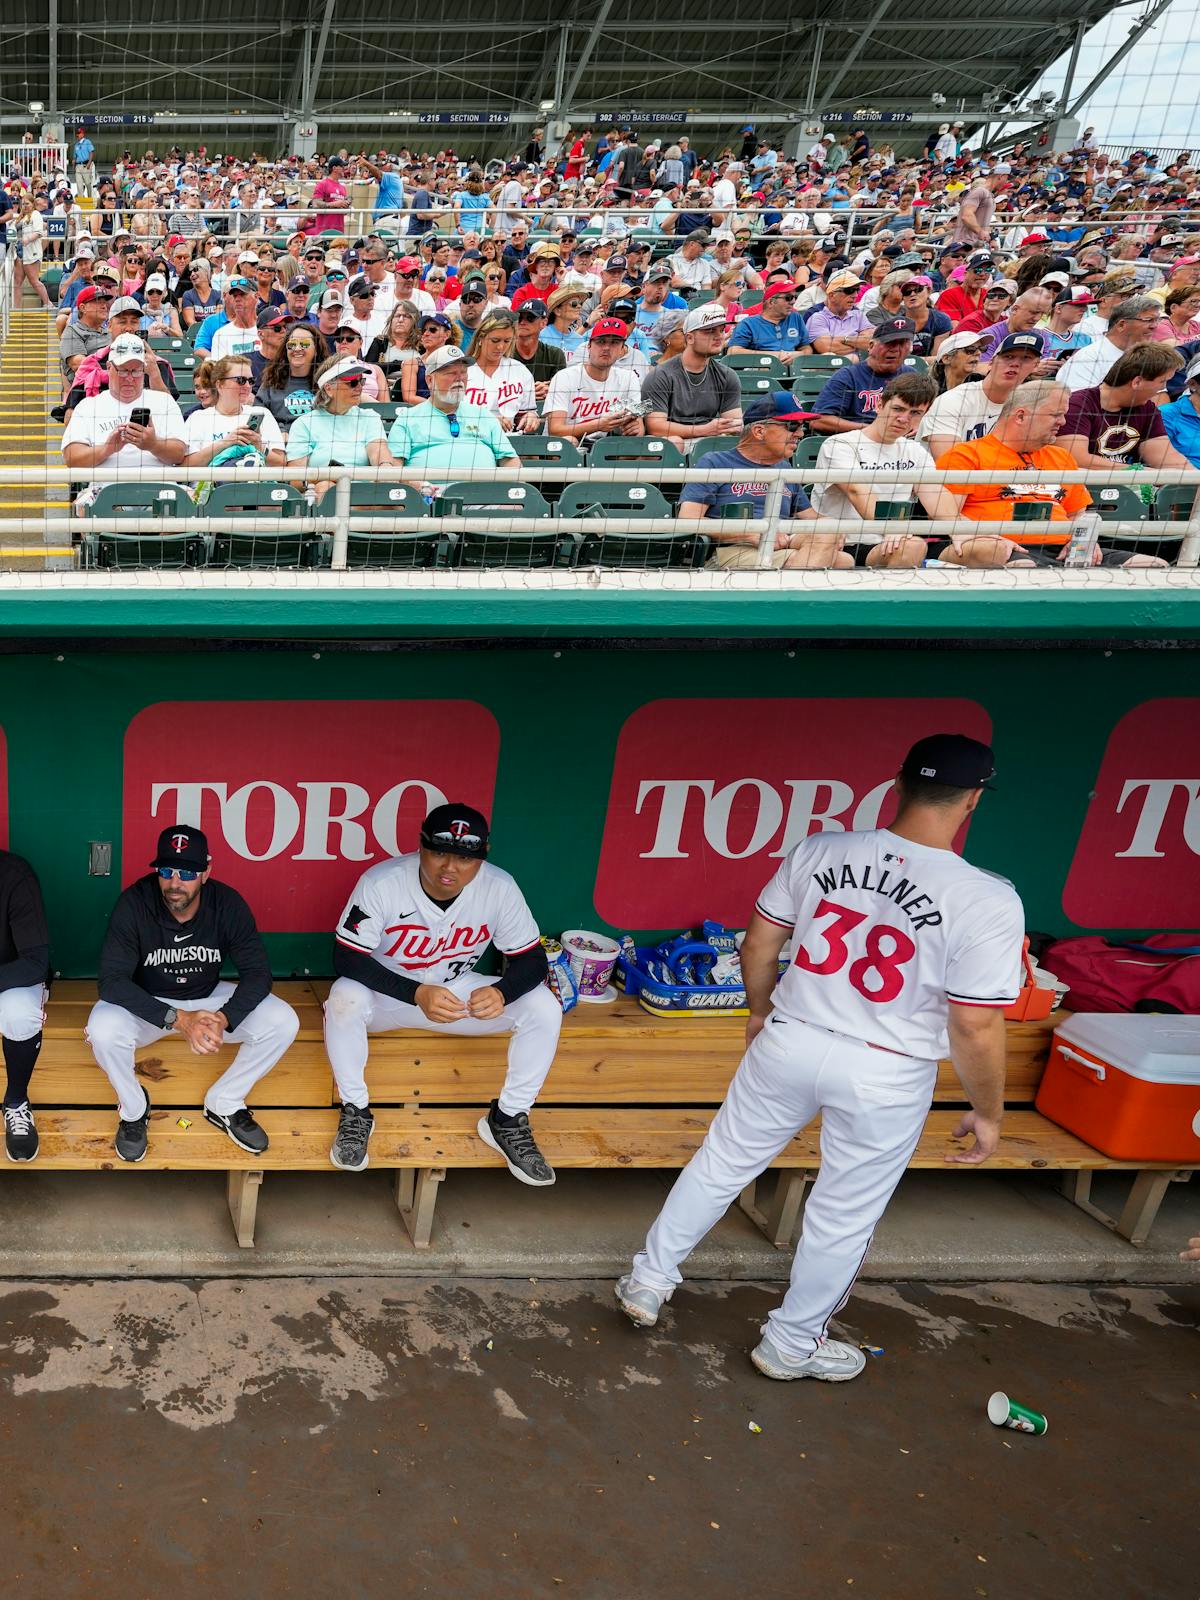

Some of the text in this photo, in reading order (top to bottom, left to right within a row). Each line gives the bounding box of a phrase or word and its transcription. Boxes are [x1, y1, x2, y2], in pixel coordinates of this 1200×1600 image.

[71, 115, 147, 124] 214 SECTION 215
[426, 114, 502, 123] 215 SECTION 216
[600, 114, 683, 122] 302 3RD BASE TERRACE
[852, 113, 882, 121] SECTION
[49, 224, 64, 233] 214
[571, 397, 614, 420] Twin
[1115, 778, 1200, 859] T
[812, 864, 943, 931] WALLNER
[384, 921, 492, 964] Twins
[793, 898, 917, 1003] 38
[143, 945, 222, 967] MINNESOTA
[163, 966, 203, 974] BASEBALL
[641, 988, 671, 1006] GIANTS
[686, 992, 746, 1007] GIANTS
